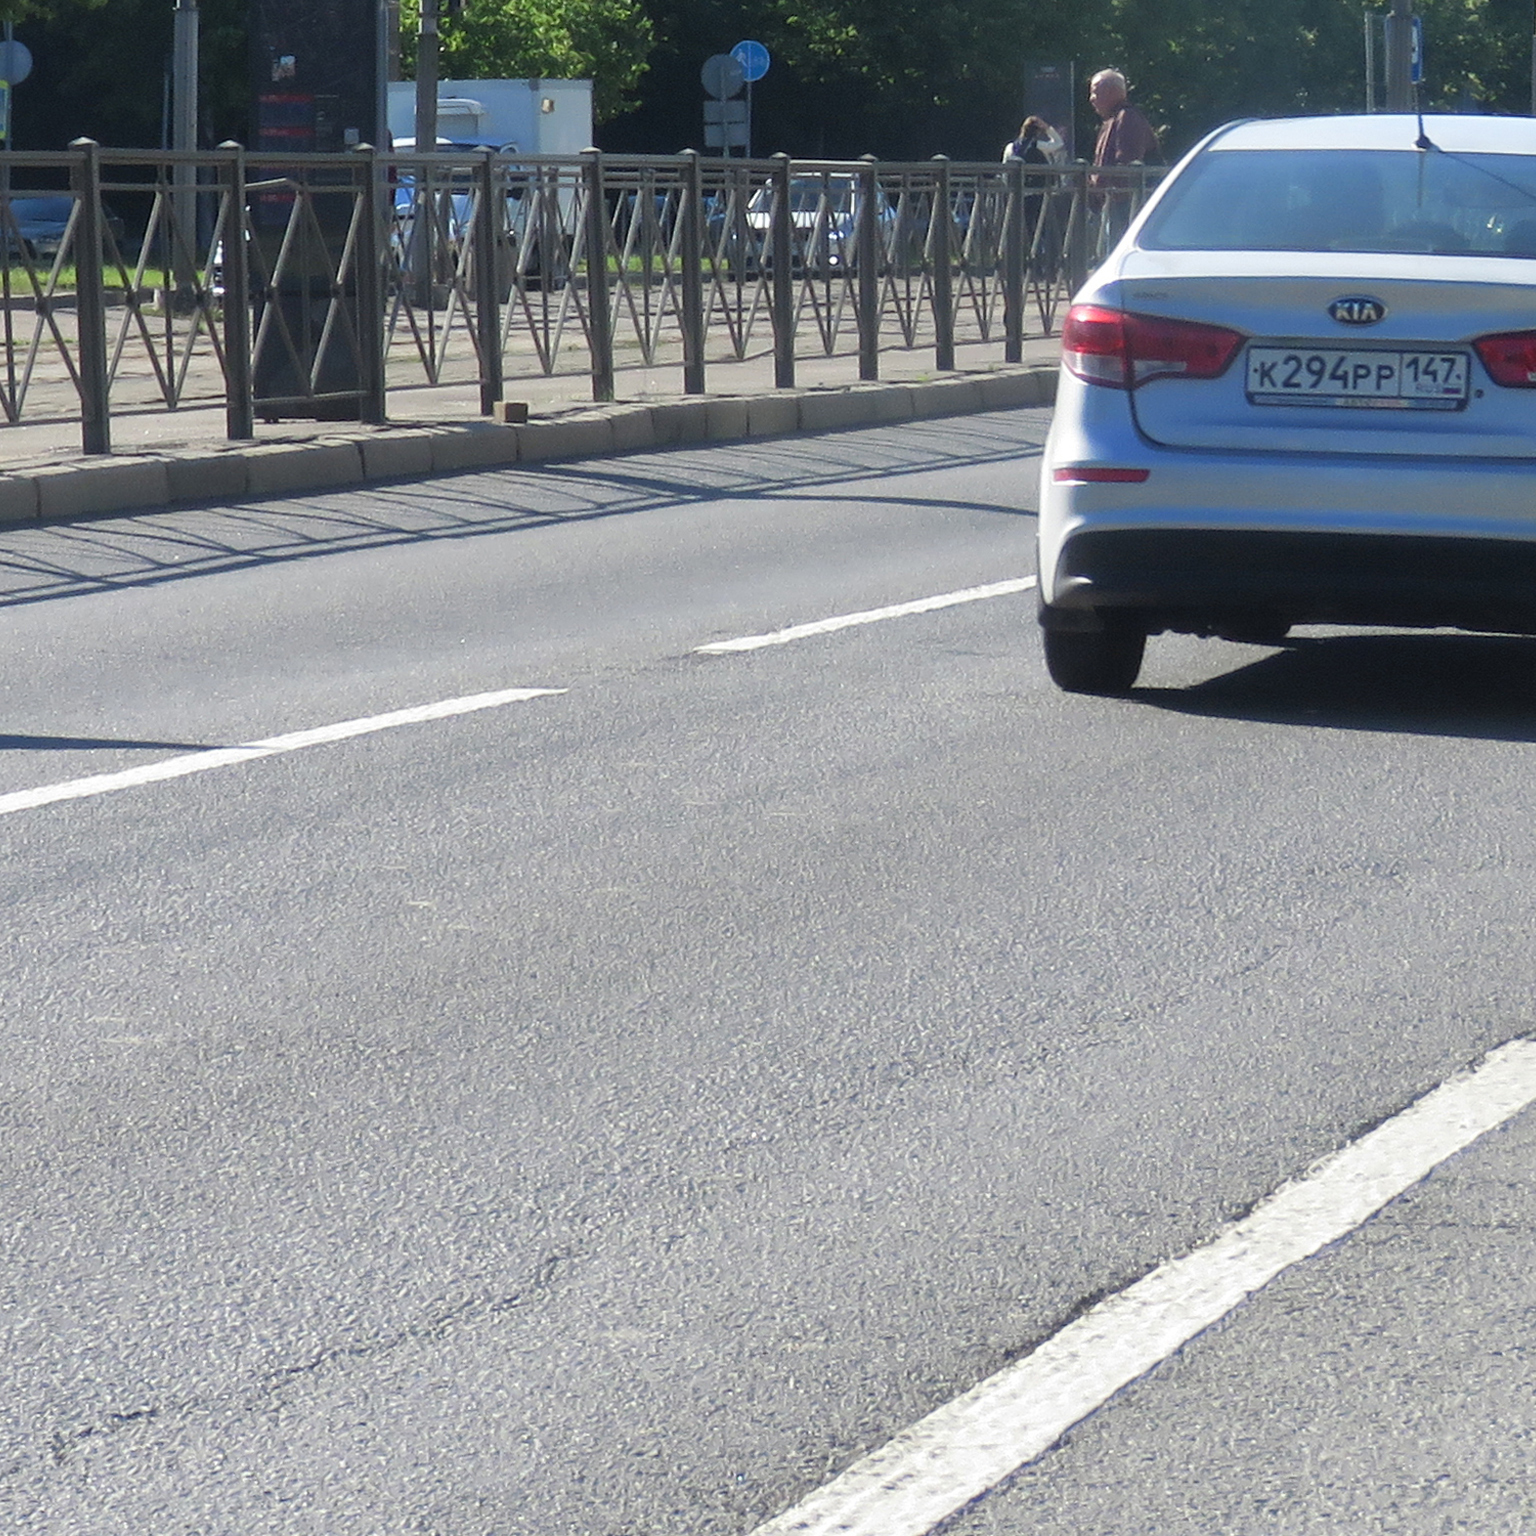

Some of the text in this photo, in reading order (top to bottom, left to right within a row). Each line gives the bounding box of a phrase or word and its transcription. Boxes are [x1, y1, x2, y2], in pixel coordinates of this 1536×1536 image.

[1335, 302, 1378, 321] KIA
[1259, 355, 1457, 390] К294РР 147
